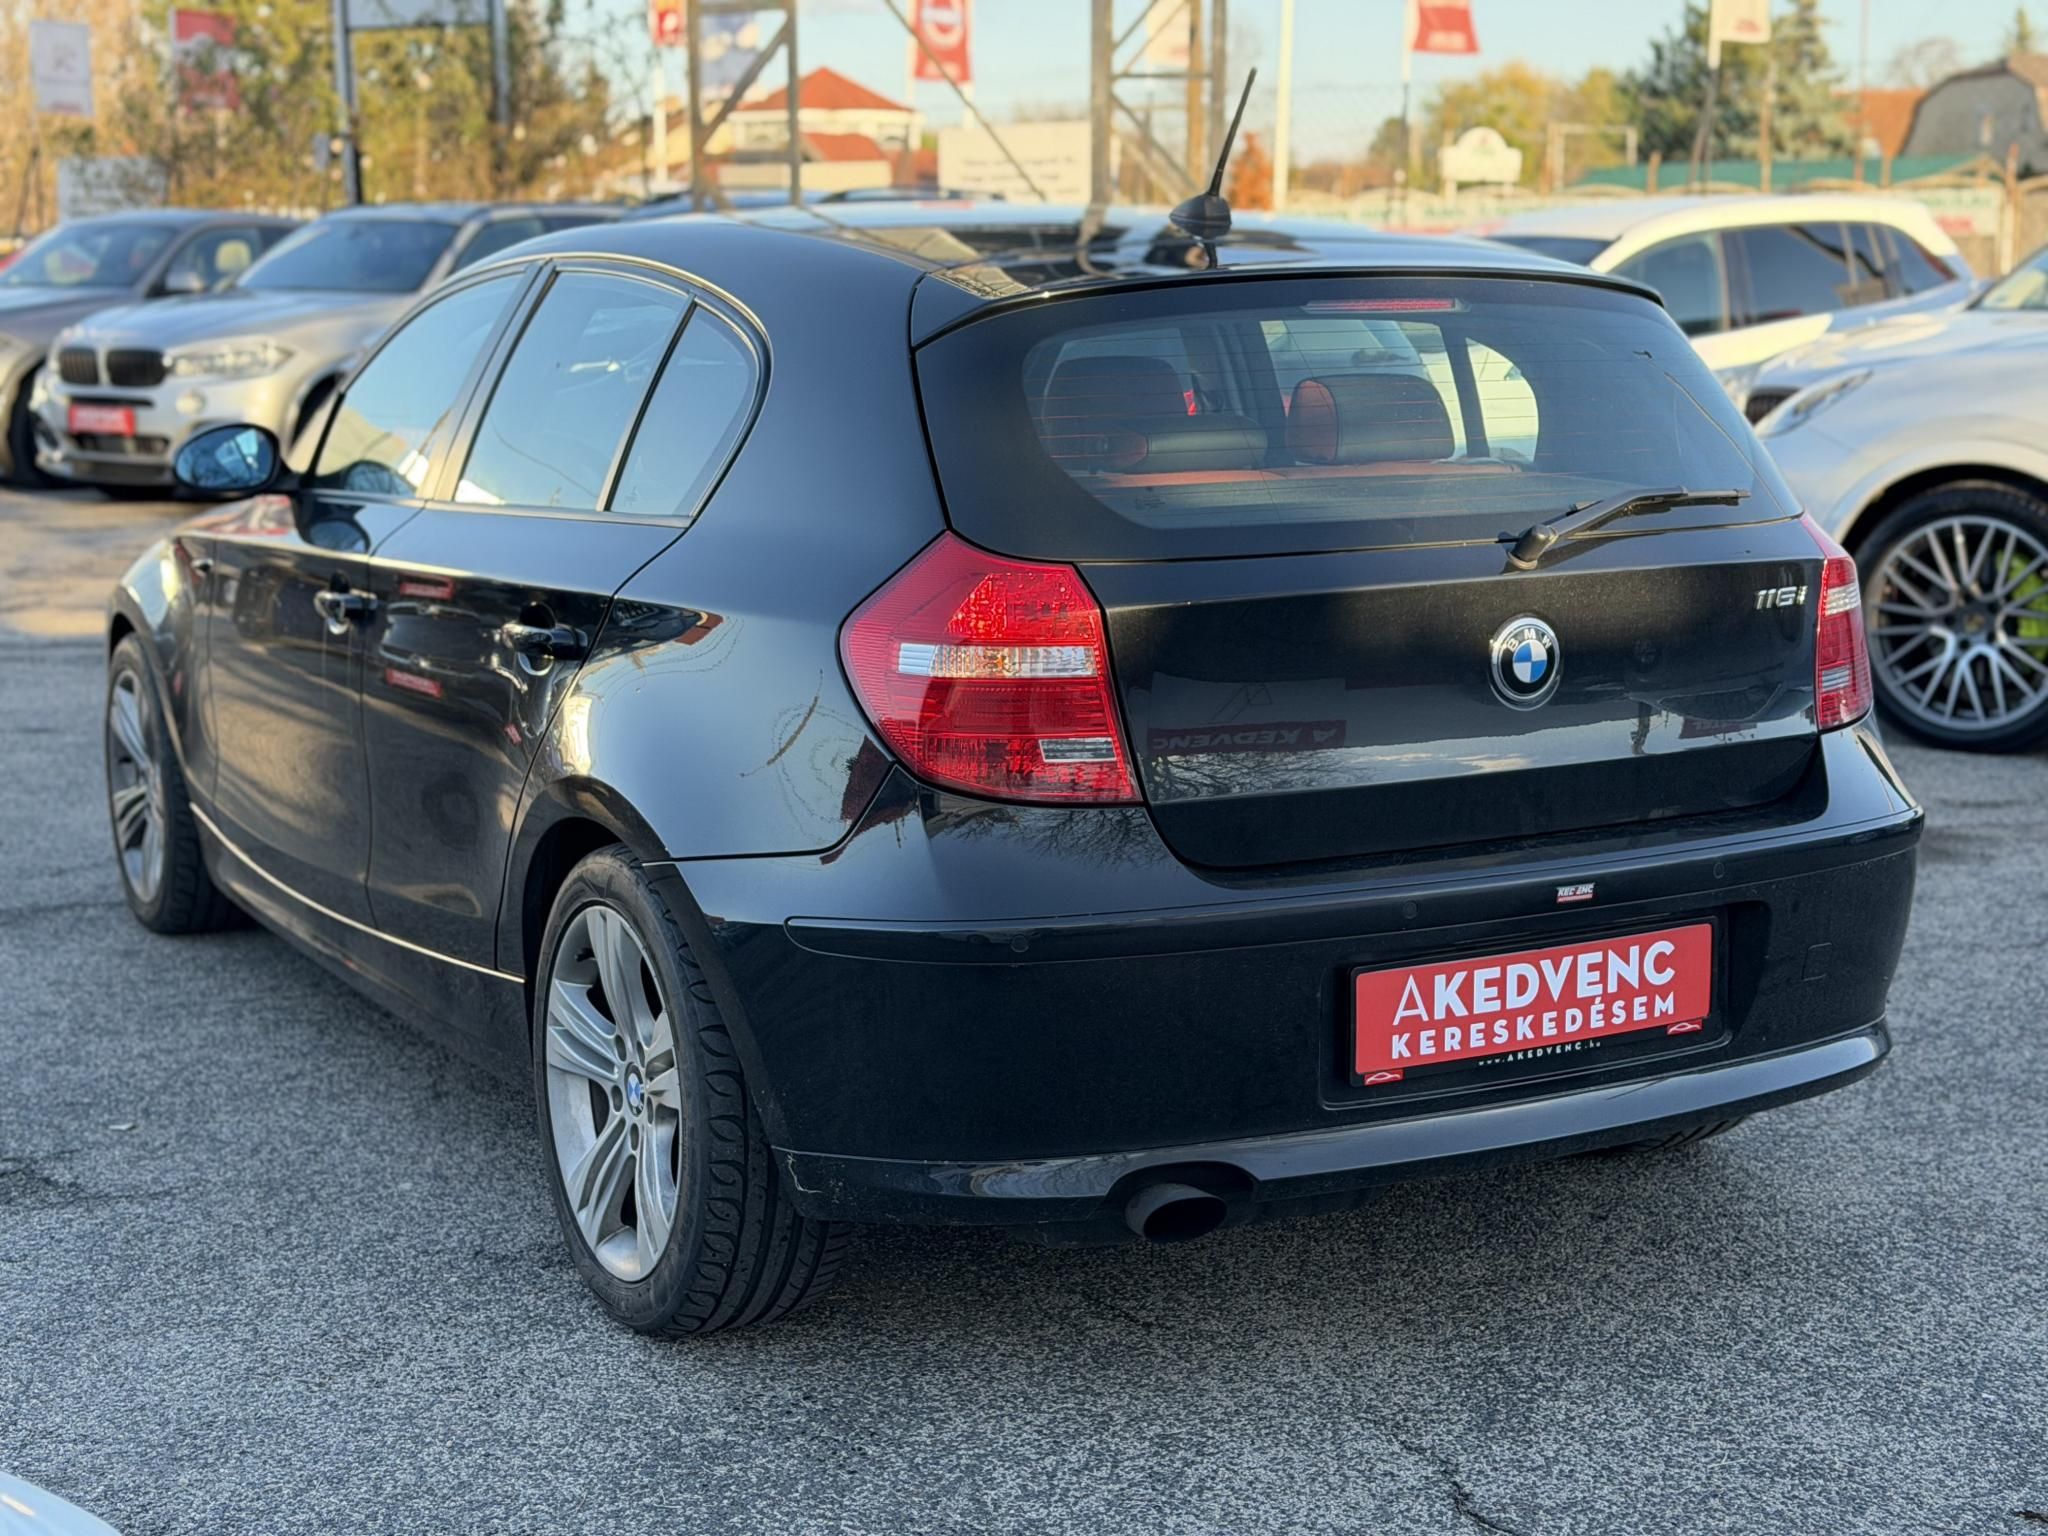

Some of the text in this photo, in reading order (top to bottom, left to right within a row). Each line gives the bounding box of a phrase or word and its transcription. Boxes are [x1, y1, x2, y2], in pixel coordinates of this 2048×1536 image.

[1756, 585, 1808, 610] 116i
[1507, 628, 1552, 652] BMW
[1152, 728, 1303, 750] KEDVENC
[1391, 991, 1676, 1060] KERESKEDÉSEM
